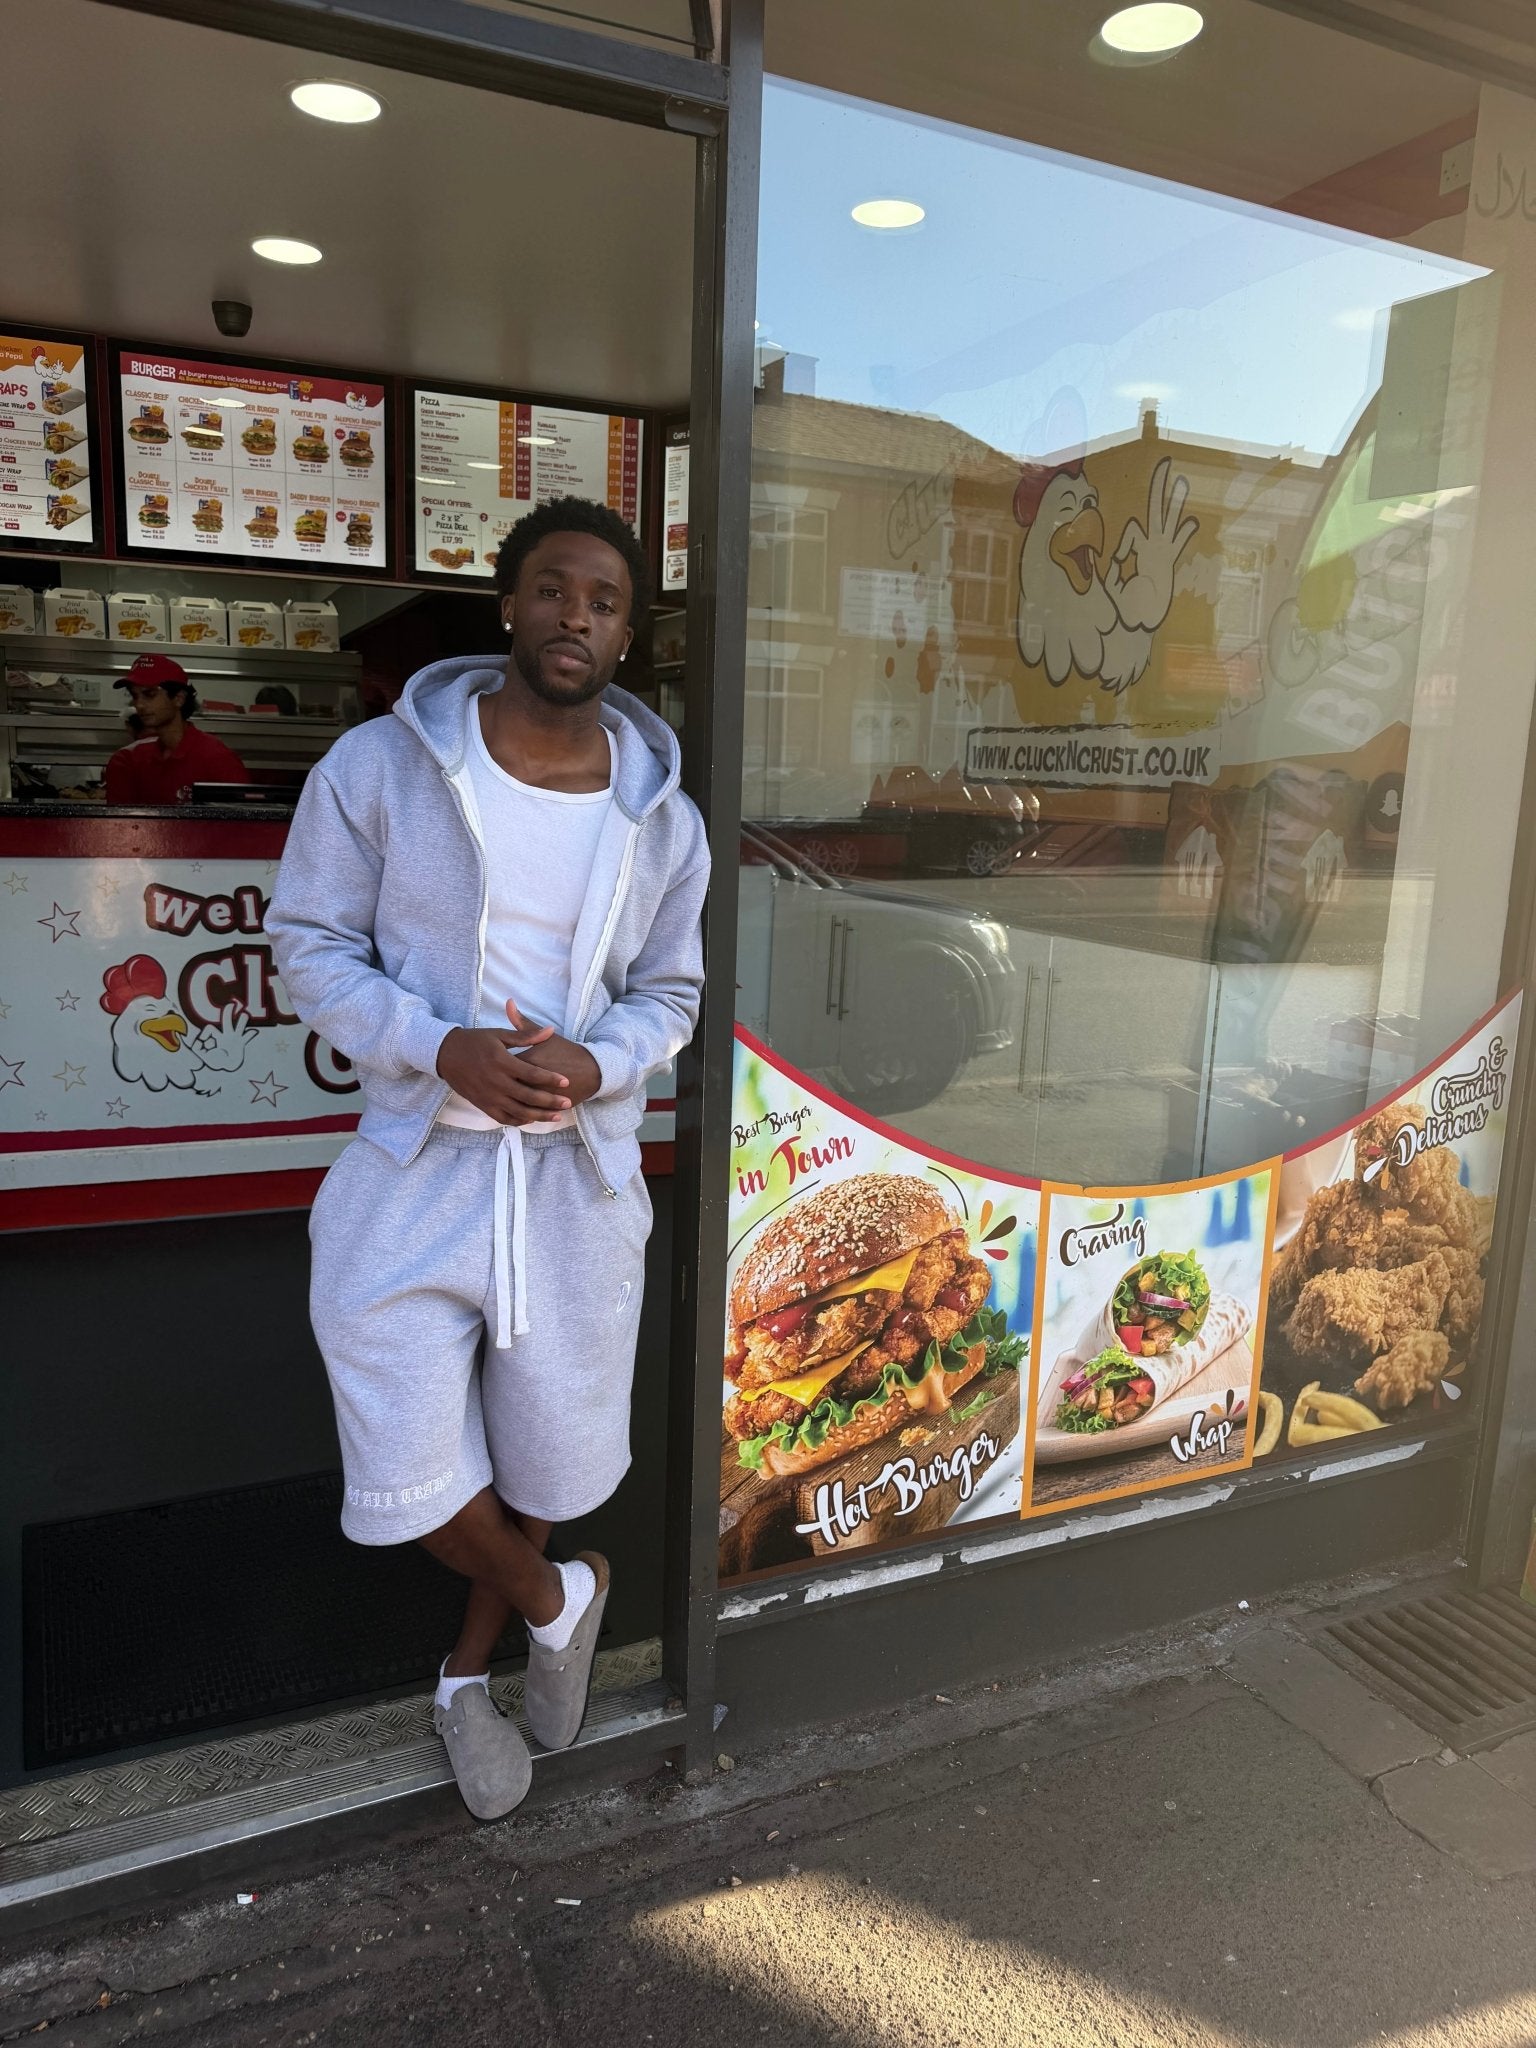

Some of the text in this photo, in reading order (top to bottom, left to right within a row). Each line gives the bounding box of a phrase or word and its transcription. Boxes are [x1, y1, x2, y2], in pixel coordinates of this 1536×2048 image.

[131, 360, 176, 379] BURGER
[187, 370, 207, 379] burger
[208, 373, 226, 381] meals
[227, 375, 249, 384] include
[273, 381, 289, 390] Pepsi
[125, 389, 152, 400] CLASSIC
[153, 392, 169, 401] BEEF
[256, 404, 279, 415] BURGER
[421, 496, 446, 506] SPECIAL
[441, 513, 446, 521] 2
[435, 521, 469, 531] PIZZA DEAL
[0, 603, 19, 611] ckeN
[972, 740, 1212, 777] WWW.CLUCKNCRUST.CO.UK
[144, 882, 274, 937] Wel
[1431, 1036, 1508, 1111] Crunchy &
[730, 1105, 812, 1148] Best Burger
[1392, 1102, 1489, 1167] Delicious
[736, 1135, 856, 1197] in Town
[1059, 1203, 1148, 1267] Craving
[1170, 1410, 1234, 1465] Wrap
[795, 1431, 1001, 1546] Hot Burger
